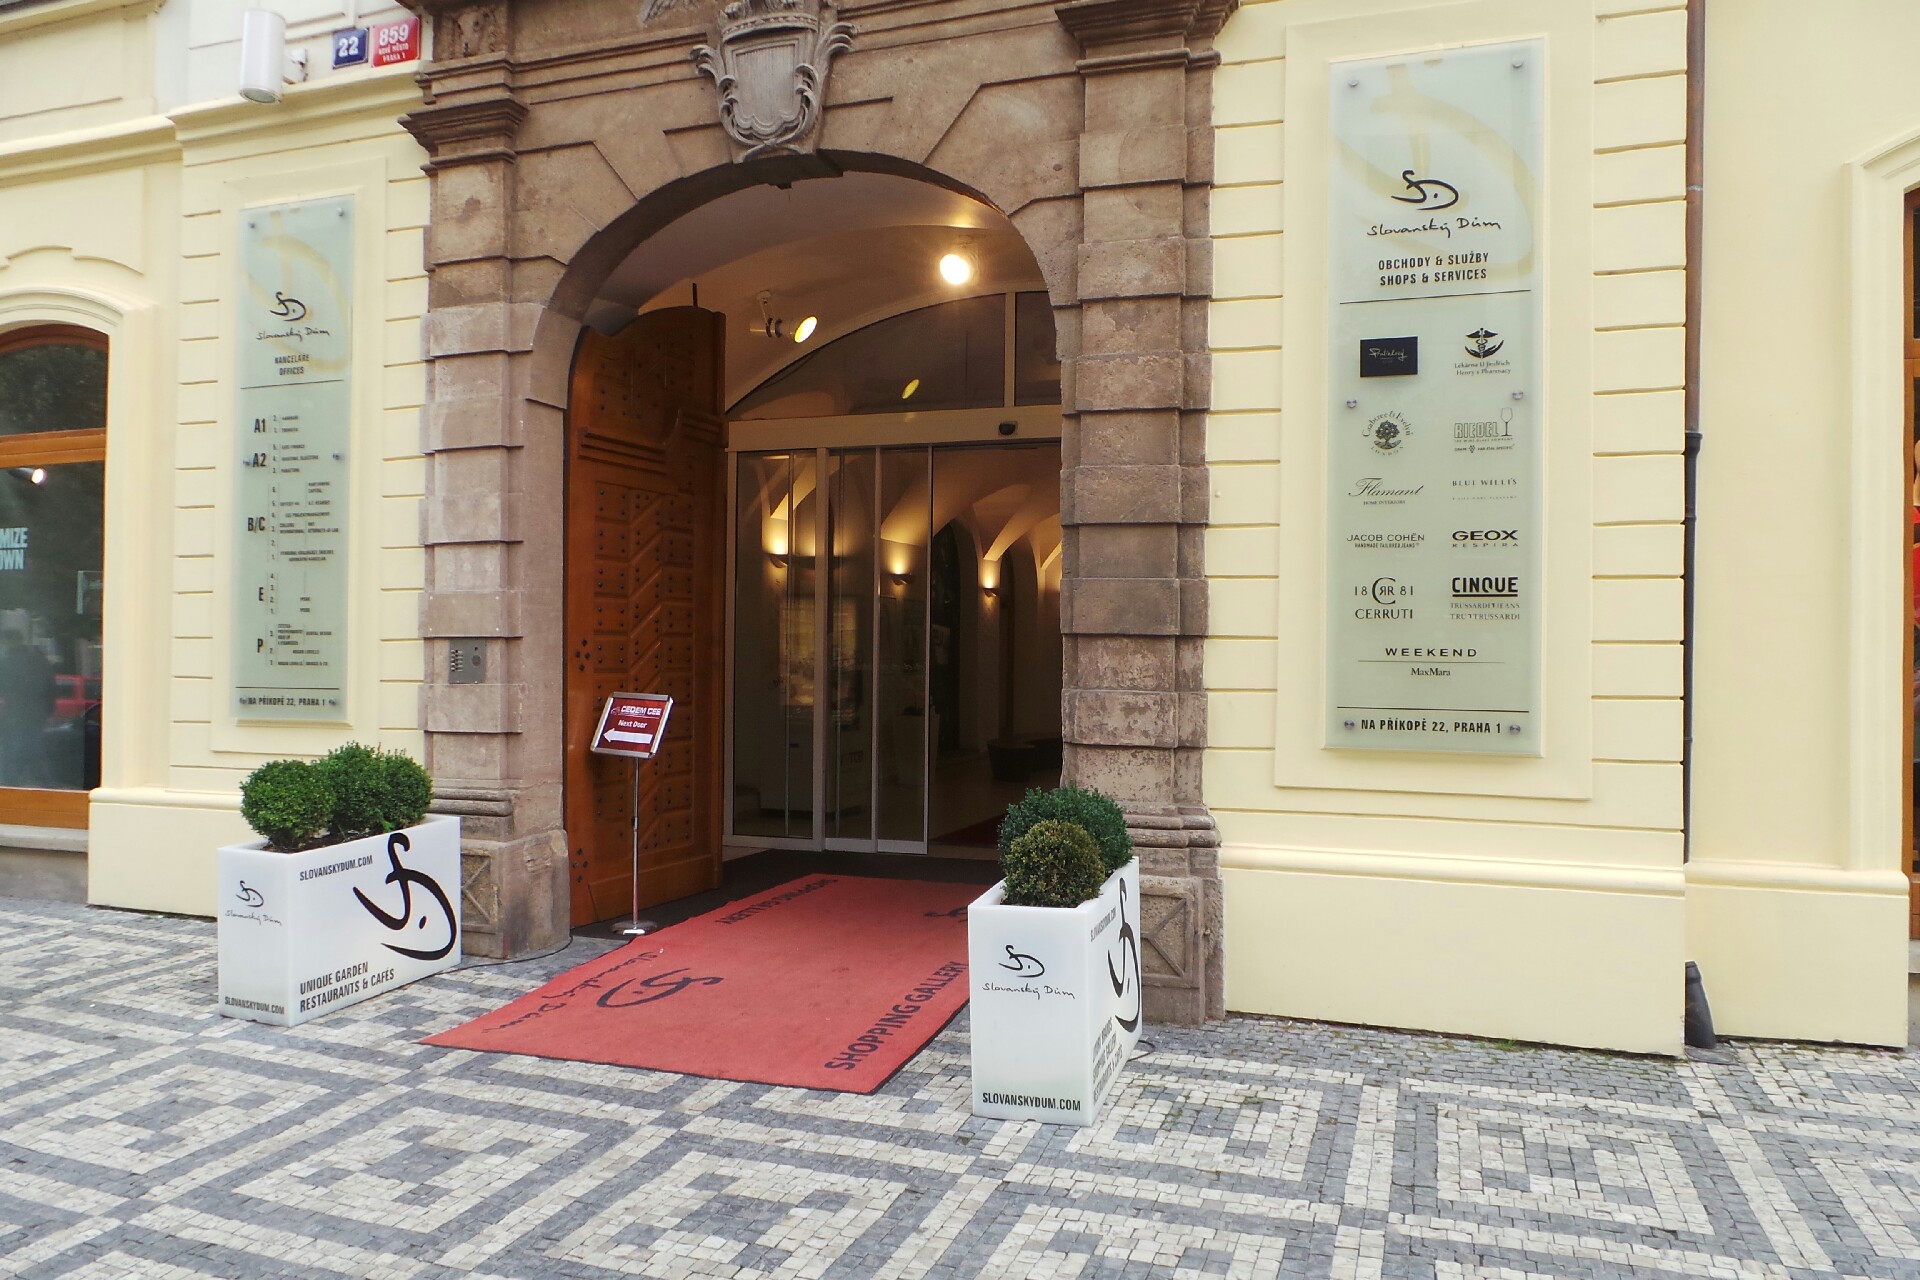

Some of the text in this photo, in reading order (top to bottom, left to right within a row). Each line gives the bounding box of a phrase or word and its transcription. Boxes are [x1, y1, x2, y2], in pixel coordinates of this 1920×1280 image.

[380, 24, 409, 46] 859
[338, 36, 359, 57] 22
[382, 53, 400, 62] PRAHA
[1378, 250, 1489, 270] OBCHODY & SLUŽBY
[1380, 268, 1487, 286] SHOPS & SERVICES
[279, 366, 304, 376] OFFICES
[254, 418, 266, 433] A1
[1454, 421, 1499, 439] RIEDEL
[253, 452, 267, 467] A2
[1348, 477, 1425, 498] Flamant
[248, 516, 265, 532] B/C
[1346, 534, 1383, 542] JACOB
[1452, 530, 1518, 541] GEOX
[1452, 577, 1519, 593] CINQUE
[258, 587, 264, 601] E
[1355, 608, 1413, 620] CERRUTI
[257, 638, 263, 653] P
[1385, 647, 1477, 657] WEEKEND
[1410, 667, 1451, 676] MaxMara
[299, 697, 320, 706] PRAHA
[618, 719, 647, 729] Next Door
[1361, 717, 1501, 733] NA PŘÍKOPĚ 22, PRAHA 1
[300, 855, 373, 881] SLOVANSKYDUM.COM
[300, 961, 368, 995] UNIQUE GARDEN
[905, 961, 969, 1003] GALLERY
[300, 967, 395, 1013] RESTAURANTS & CAFÉS
[225, 996, 285, 1015] SLOVANSKYDUM.COM
[824, 1003, 922, 1071] SHOPPING
[982, 1091, 1081, 1112] SLOVANSKYDUM.COM
